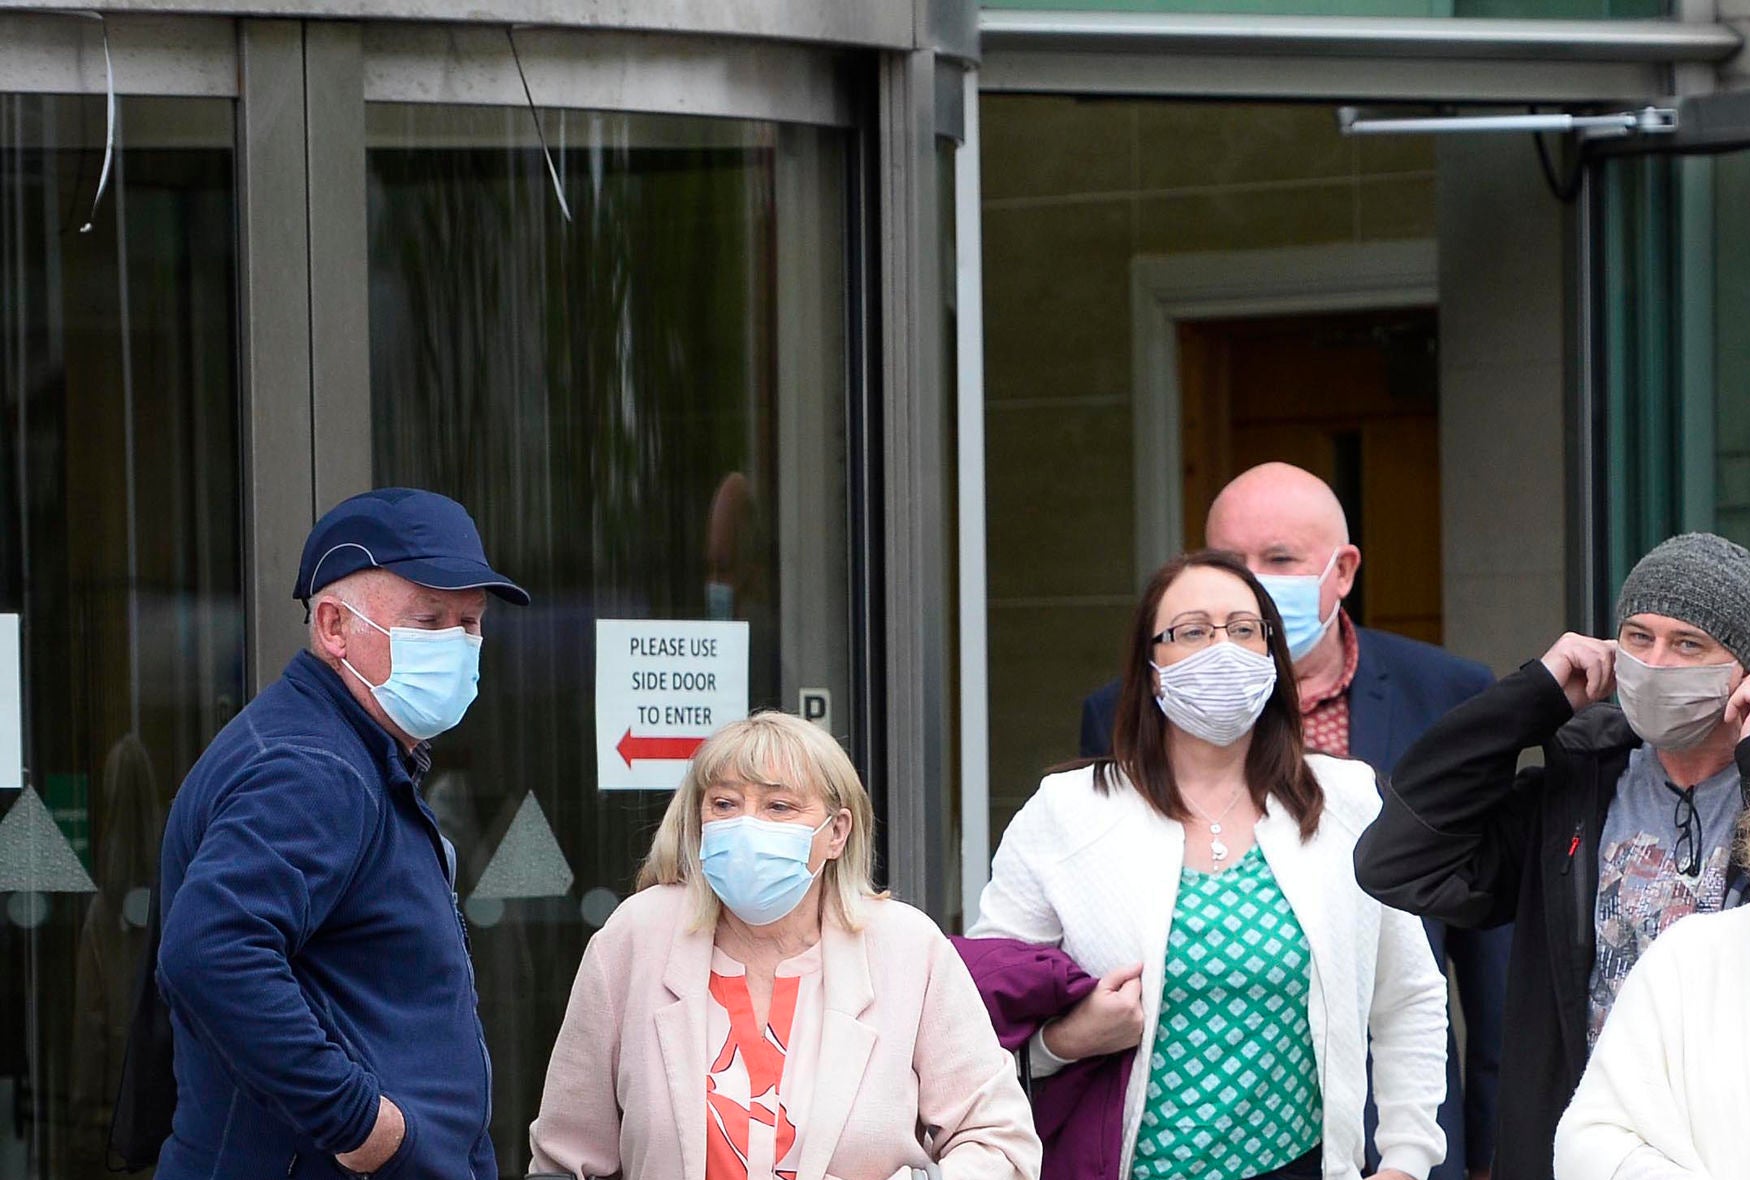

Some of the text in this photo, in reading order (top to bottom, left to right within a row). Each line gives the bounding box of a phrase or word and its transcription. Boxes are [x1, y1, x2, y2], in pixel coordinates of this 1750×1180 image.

[630, 637, 717, 657] PLEASE USE
[632, 671, 717, 691] SIDE DOOR
[637, 706, 712, 725] TO ENTER
[805, 695, 826, 721] P
